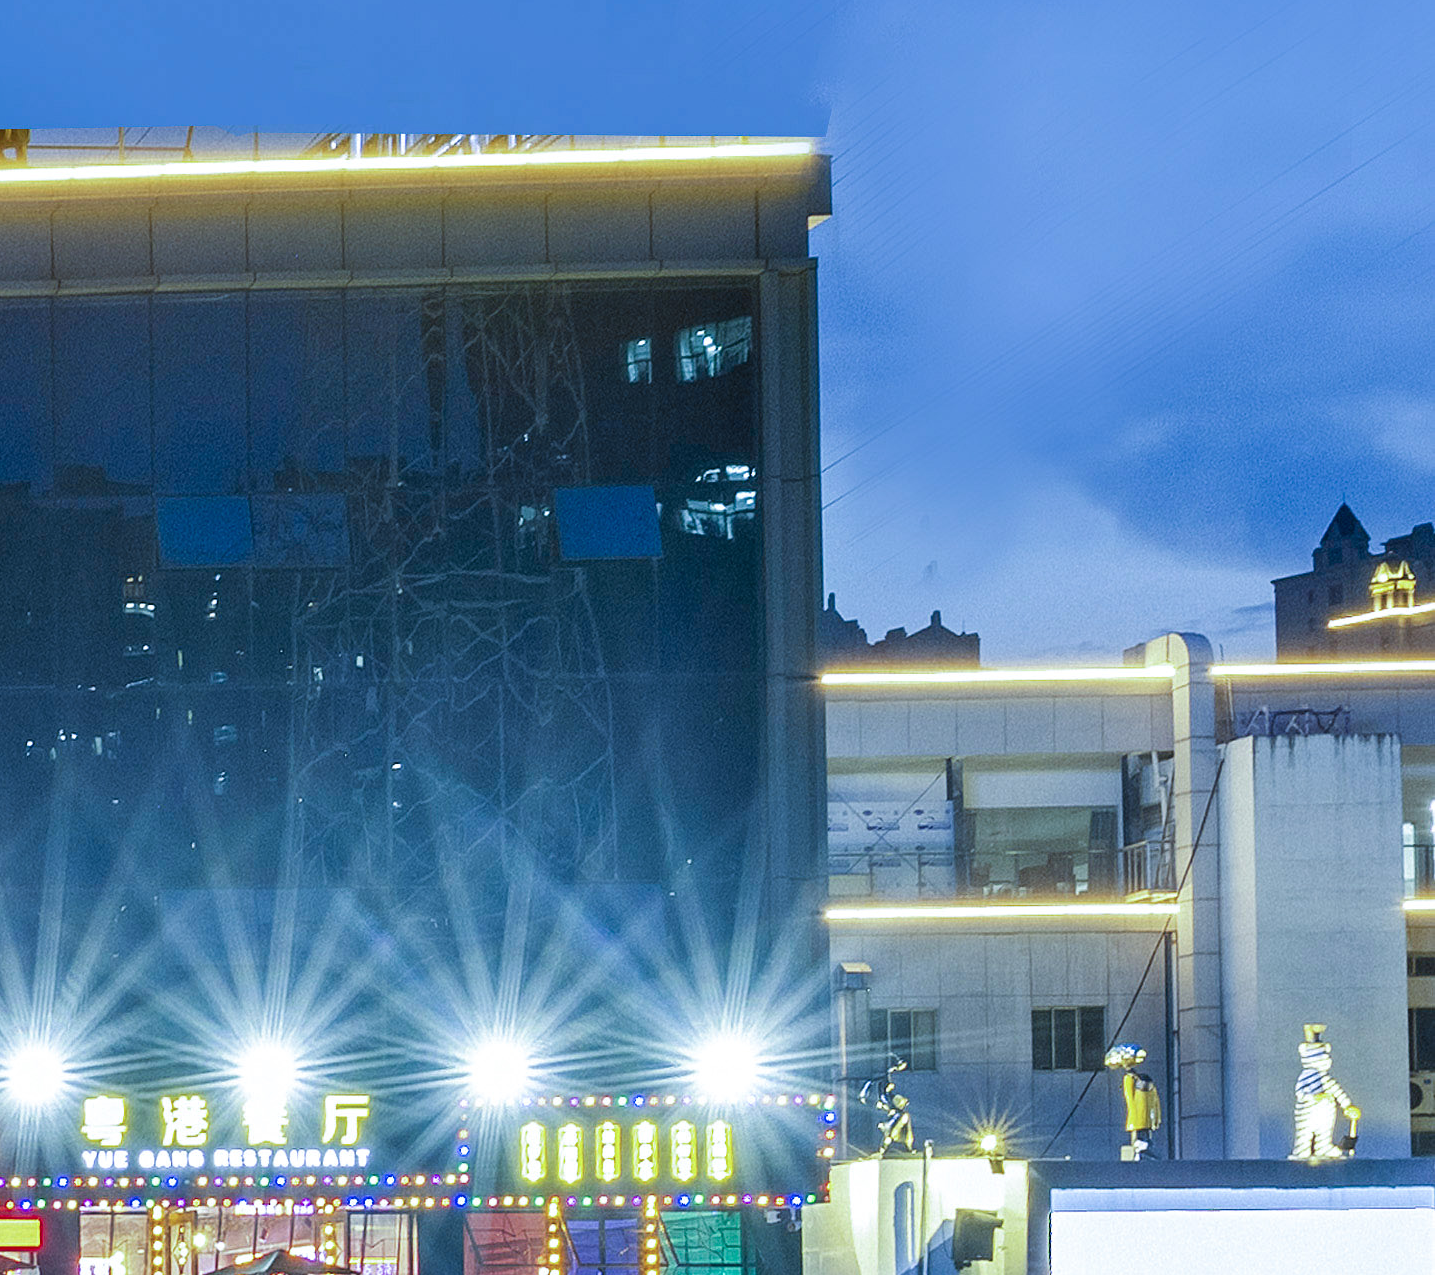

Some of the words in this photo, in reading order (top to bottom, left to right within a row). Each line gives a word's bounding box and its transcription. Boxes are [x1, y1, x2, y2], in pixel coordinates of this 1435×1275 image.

[80, 1094, 371, 1147] 粤港餐厅
[81, 1148, 129, 1169] YUE
[138, 1148, 205, 1169] GANG
[213, 1148, 371, 1169] RESTAURANT
